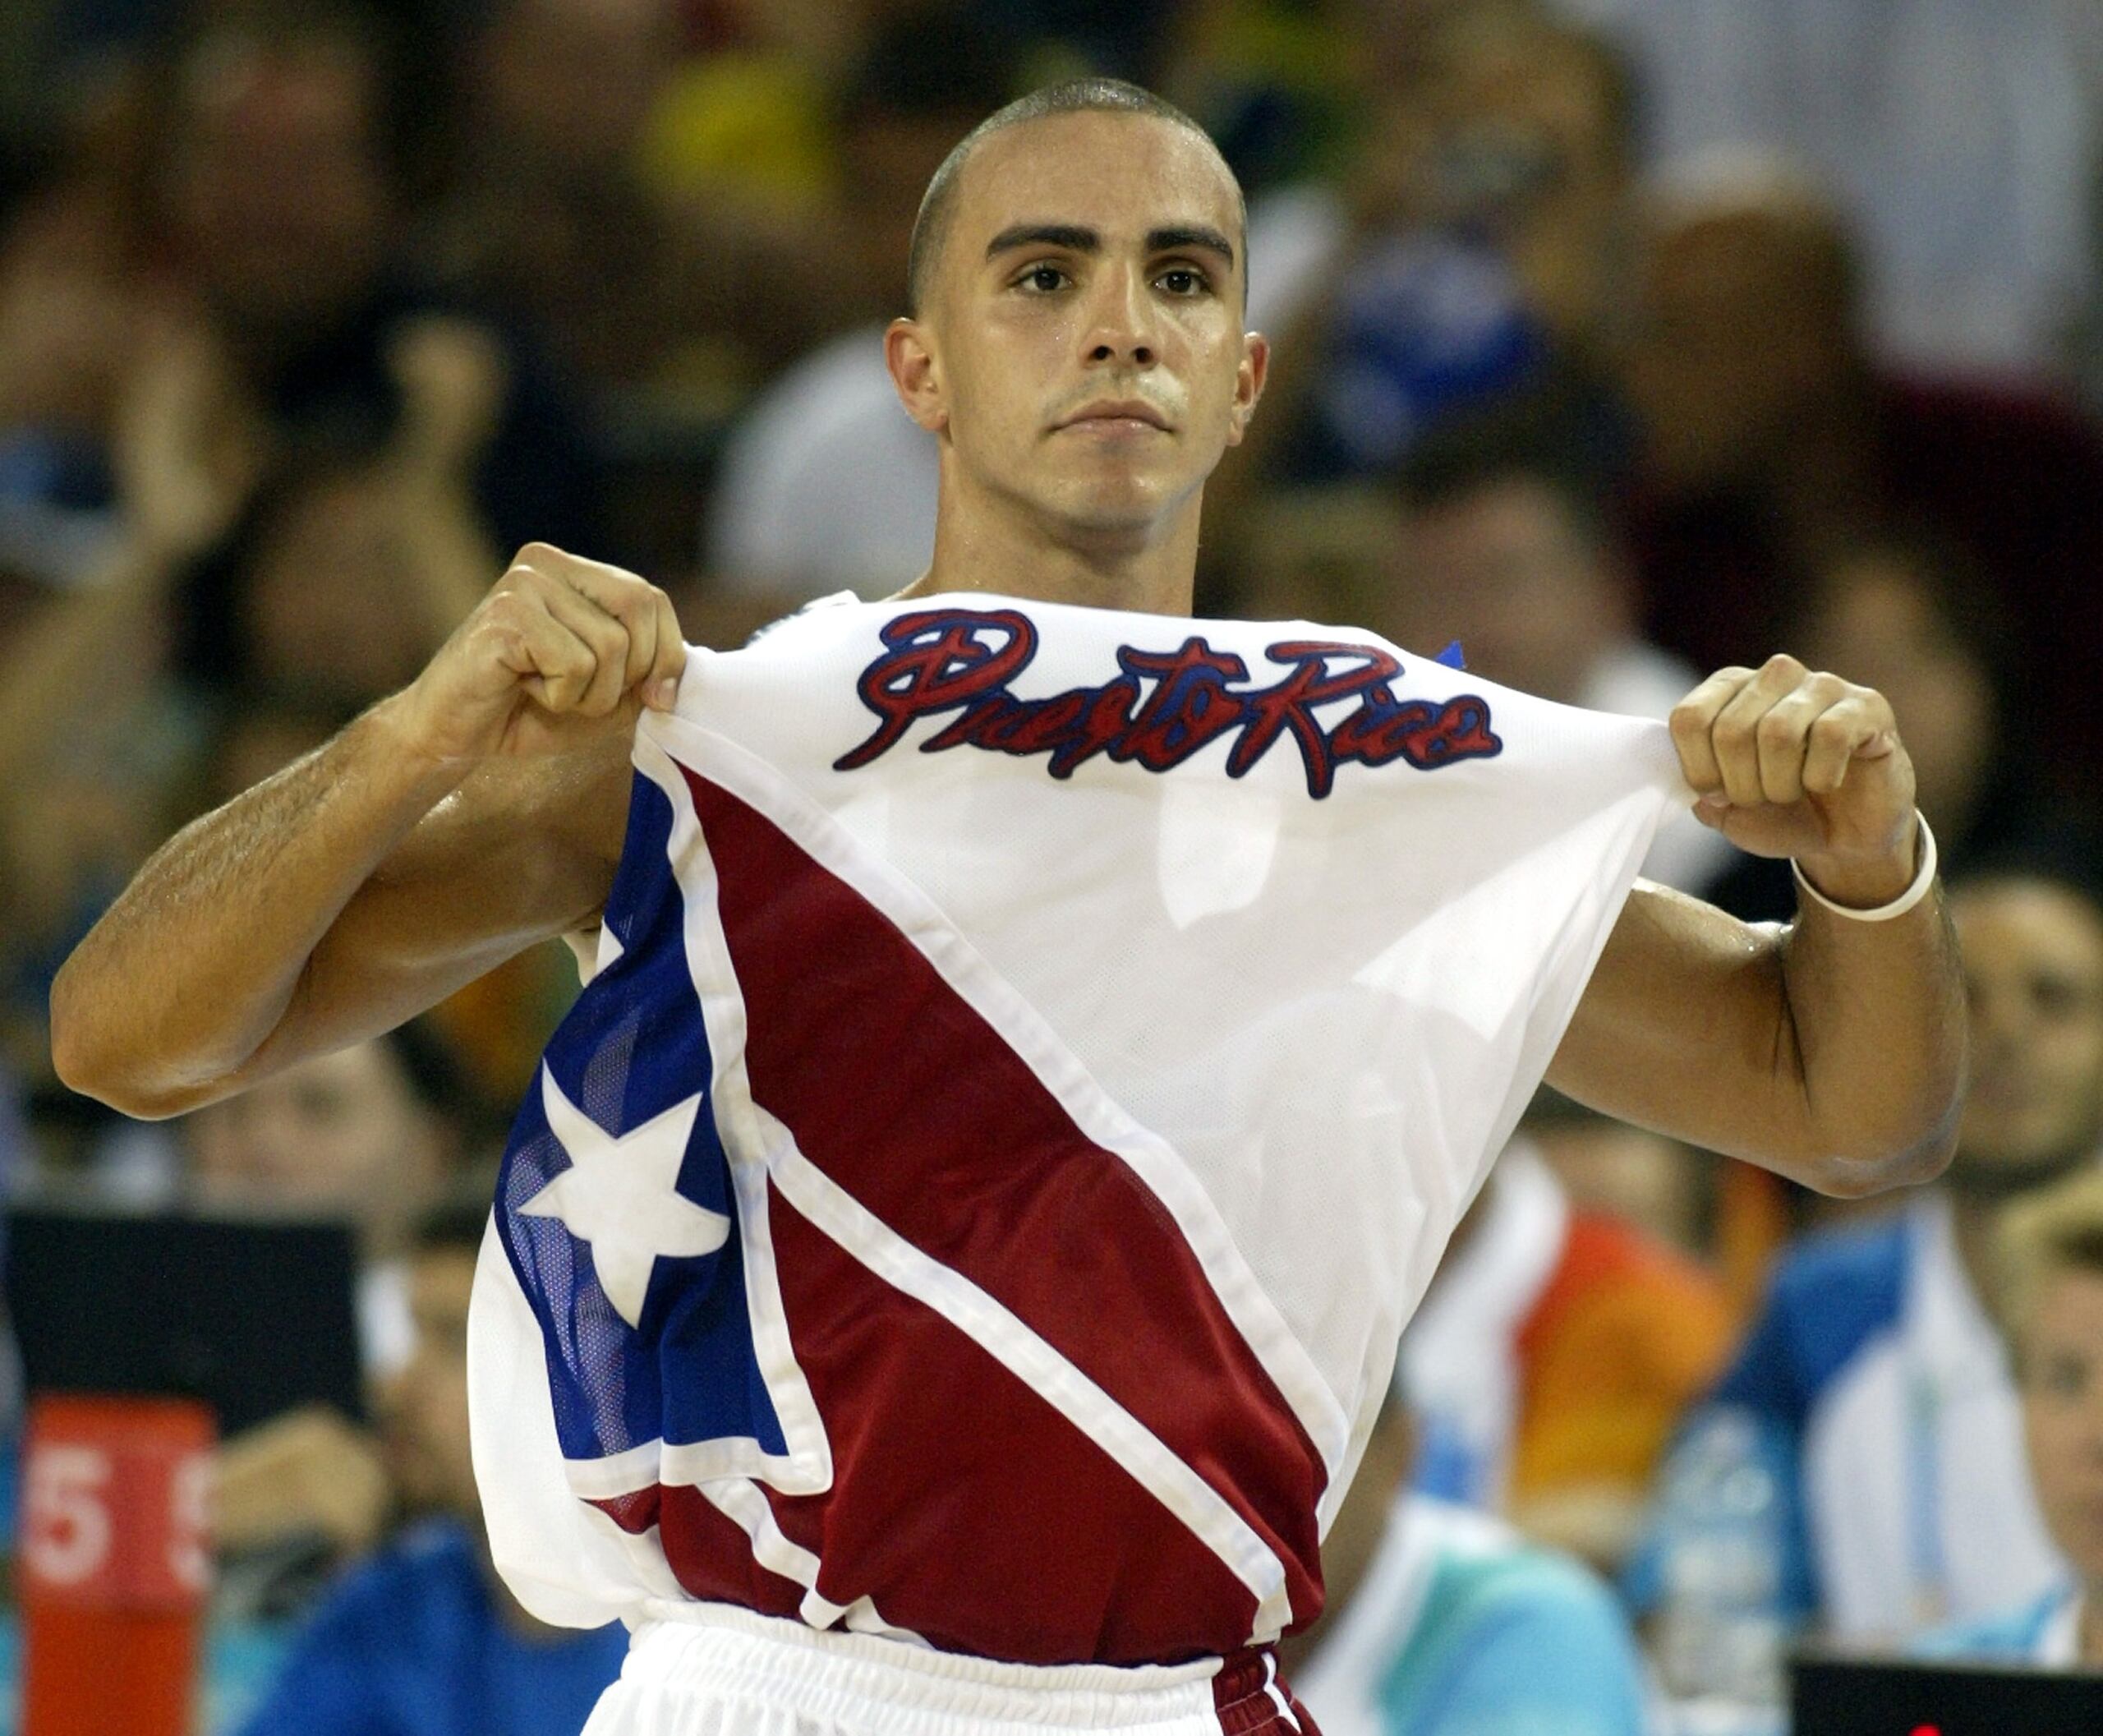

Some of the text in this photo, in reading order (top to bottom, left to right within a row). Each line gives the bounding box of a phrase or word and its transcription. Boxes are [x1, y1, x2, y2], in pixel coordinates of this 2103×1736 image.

[833, 608, 1503, 800] Puerto Rico
[24, 1444, 112, 1584] 5
